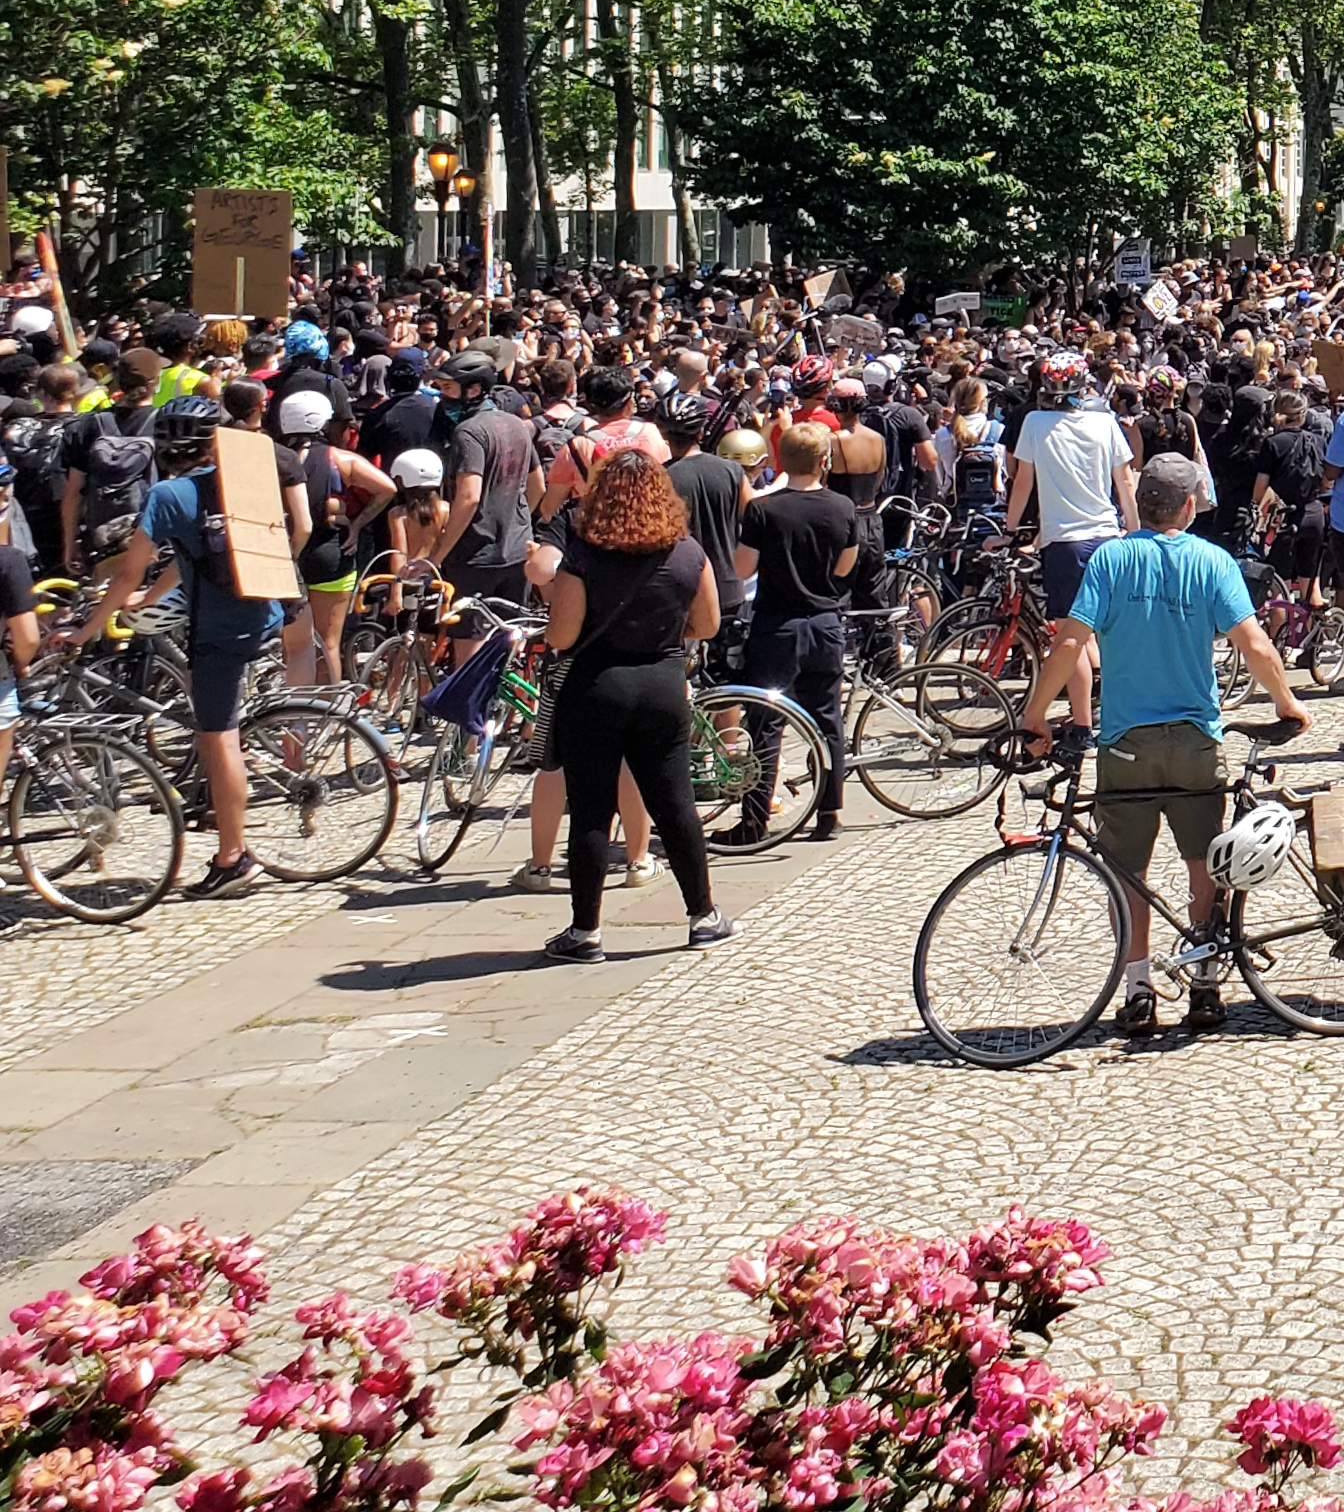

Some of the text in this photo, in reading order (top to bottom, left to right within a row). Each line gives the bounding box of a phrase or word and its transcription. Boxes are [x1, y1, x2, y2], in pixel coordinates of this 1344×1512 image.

[211, 191, 279, 216] ARTISTS
[231, 213, 258, 231] FOR
[202, 227, 284, 250] GEORGE
[1147, 287, 1174, 315] LOVE
